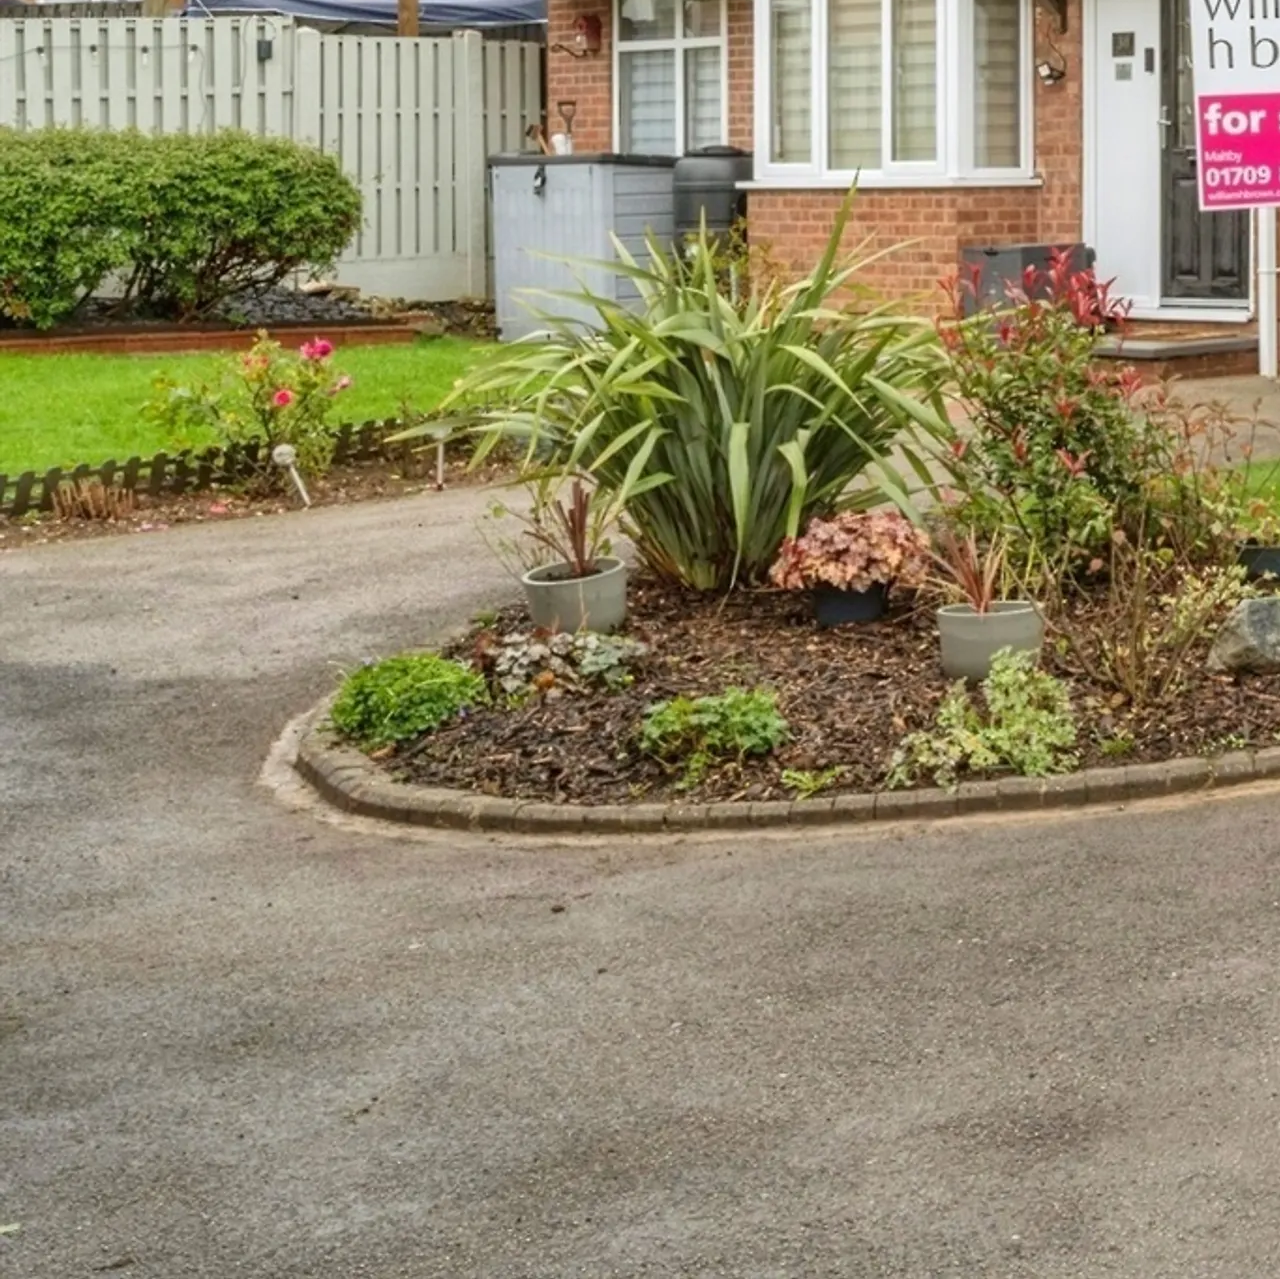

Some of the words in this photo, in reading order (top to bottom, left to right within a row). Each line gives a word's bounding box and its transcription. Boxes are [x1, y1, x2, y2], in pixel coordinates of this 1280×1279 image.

[1208, 27, 1234, 69] h
[1204, 103, 1266, 136] for
[1206, 165, 1271, 187] 01709
